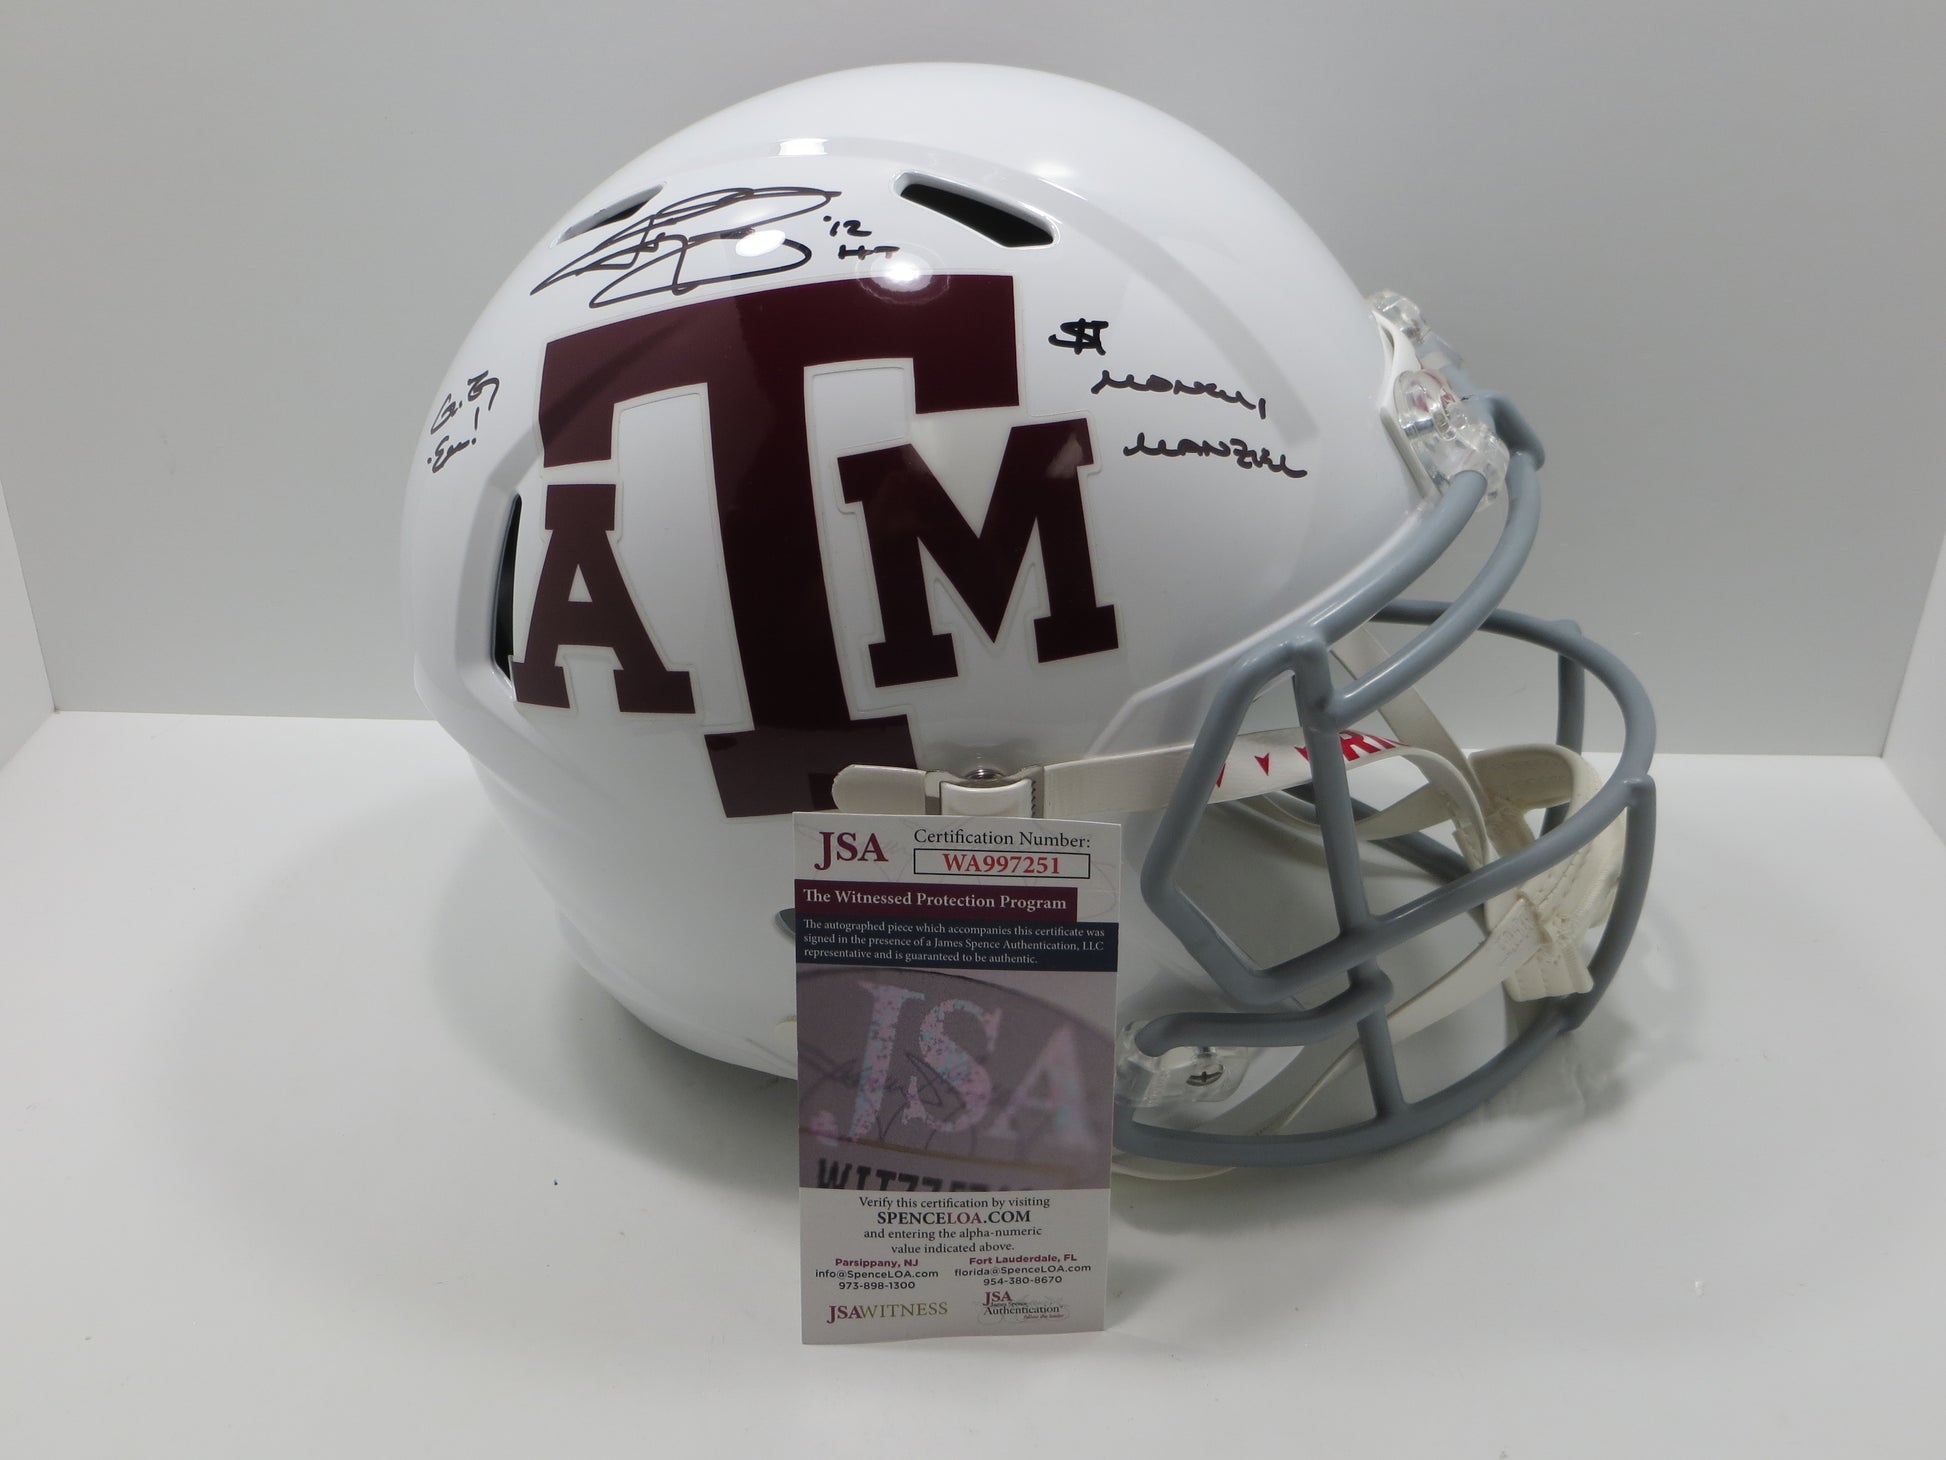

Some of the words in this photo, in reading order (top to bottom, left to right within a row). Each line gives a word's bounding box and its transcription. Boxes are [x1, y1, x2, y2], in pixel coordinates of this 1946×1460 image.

[914, 829, 1014, 846] Certification
[1019, 831, 1090, 848] Number:
[814, 831, 888, 870] JSA
[942, 853, 1060, 874] WA997251
[804, 889, 831, 903] The
[835, 889, 912, 905] Witnessed
[916, 893, 995, 908] Protection
[1000, 896, 1067, 912] Program
[804, 919, 822, 929] The
[824, 920, 885, 933] autographed
[888, 923, 913, 935] piece
[915, 923, 946, 934] which
[948, 925, 1012, 938] accompanies
[1014, 926, 1032, 936] this
[1035, 927, 1084, 937] certificate
[1086, 929, 1105, 937] was
[804, 934, 834, 946] signed
[838, 935, 848, 943] in
[850, 936, 867, 945] the
[868, 937, 909, 948] presence
[914, 936, 922, 946] of
[926, 939, 931, 947] a
[934, 937, 963, 950] James
[965, 939, 1000, 951] Spence
[1002, 939, 1080, 951] Authentication,
[1082, 941, 1104, 950] LLC
[804, 948, 872, 961] representative
[874, 950, 892, 959] and
[895, 951, 903, 960] is
[905, 951, 960, 964] guaranteed
[962, 952, 972, 961] to
[974, 952, 987, 962] be
[989, 953, 1038, 964] authentic.
[859, 1196, 894, 1210] Verify
[896, 1197, 918, 1208] this
[921, 1197, 989, 1208] certification
[991, 1197, 1006, 1209] by
[1009, 1196, 1050, 1209] visiting
[877, 1210, 1030, 1224] SPENCELOA.COM
[864, 1228, 885, 1239] and
[888, 1228, 935, 1241] entering
[938, 1228, 957, 1238] the
[959, 1226, 1042, 1240] alpha-numeric
[891, 1244, 921, 1254] value
[924, 1242, 976, 1253] indicated
[979, 1242, 1014, 1252] above.
[835, 1258, 900, 1269] Parsippany,
[904, 1258, 919, 1267] NJ
[969, 1256, 993, 1265] Fort
[996, 1254, 1061, 1264] Lauderdale,
[1064, 1254, 1077, 1262] FL
[815, 1269, 938, 1280] info@SpenceLOA.com
[954, 1264, 1091, 1277] florida@SpenceLOA.com
[838, 1281, 916, 1290] 973-898-1300
[983, 1276, 1062, 1285] 954-380-8670
[983, 1291, 1012, 1306] JSA
